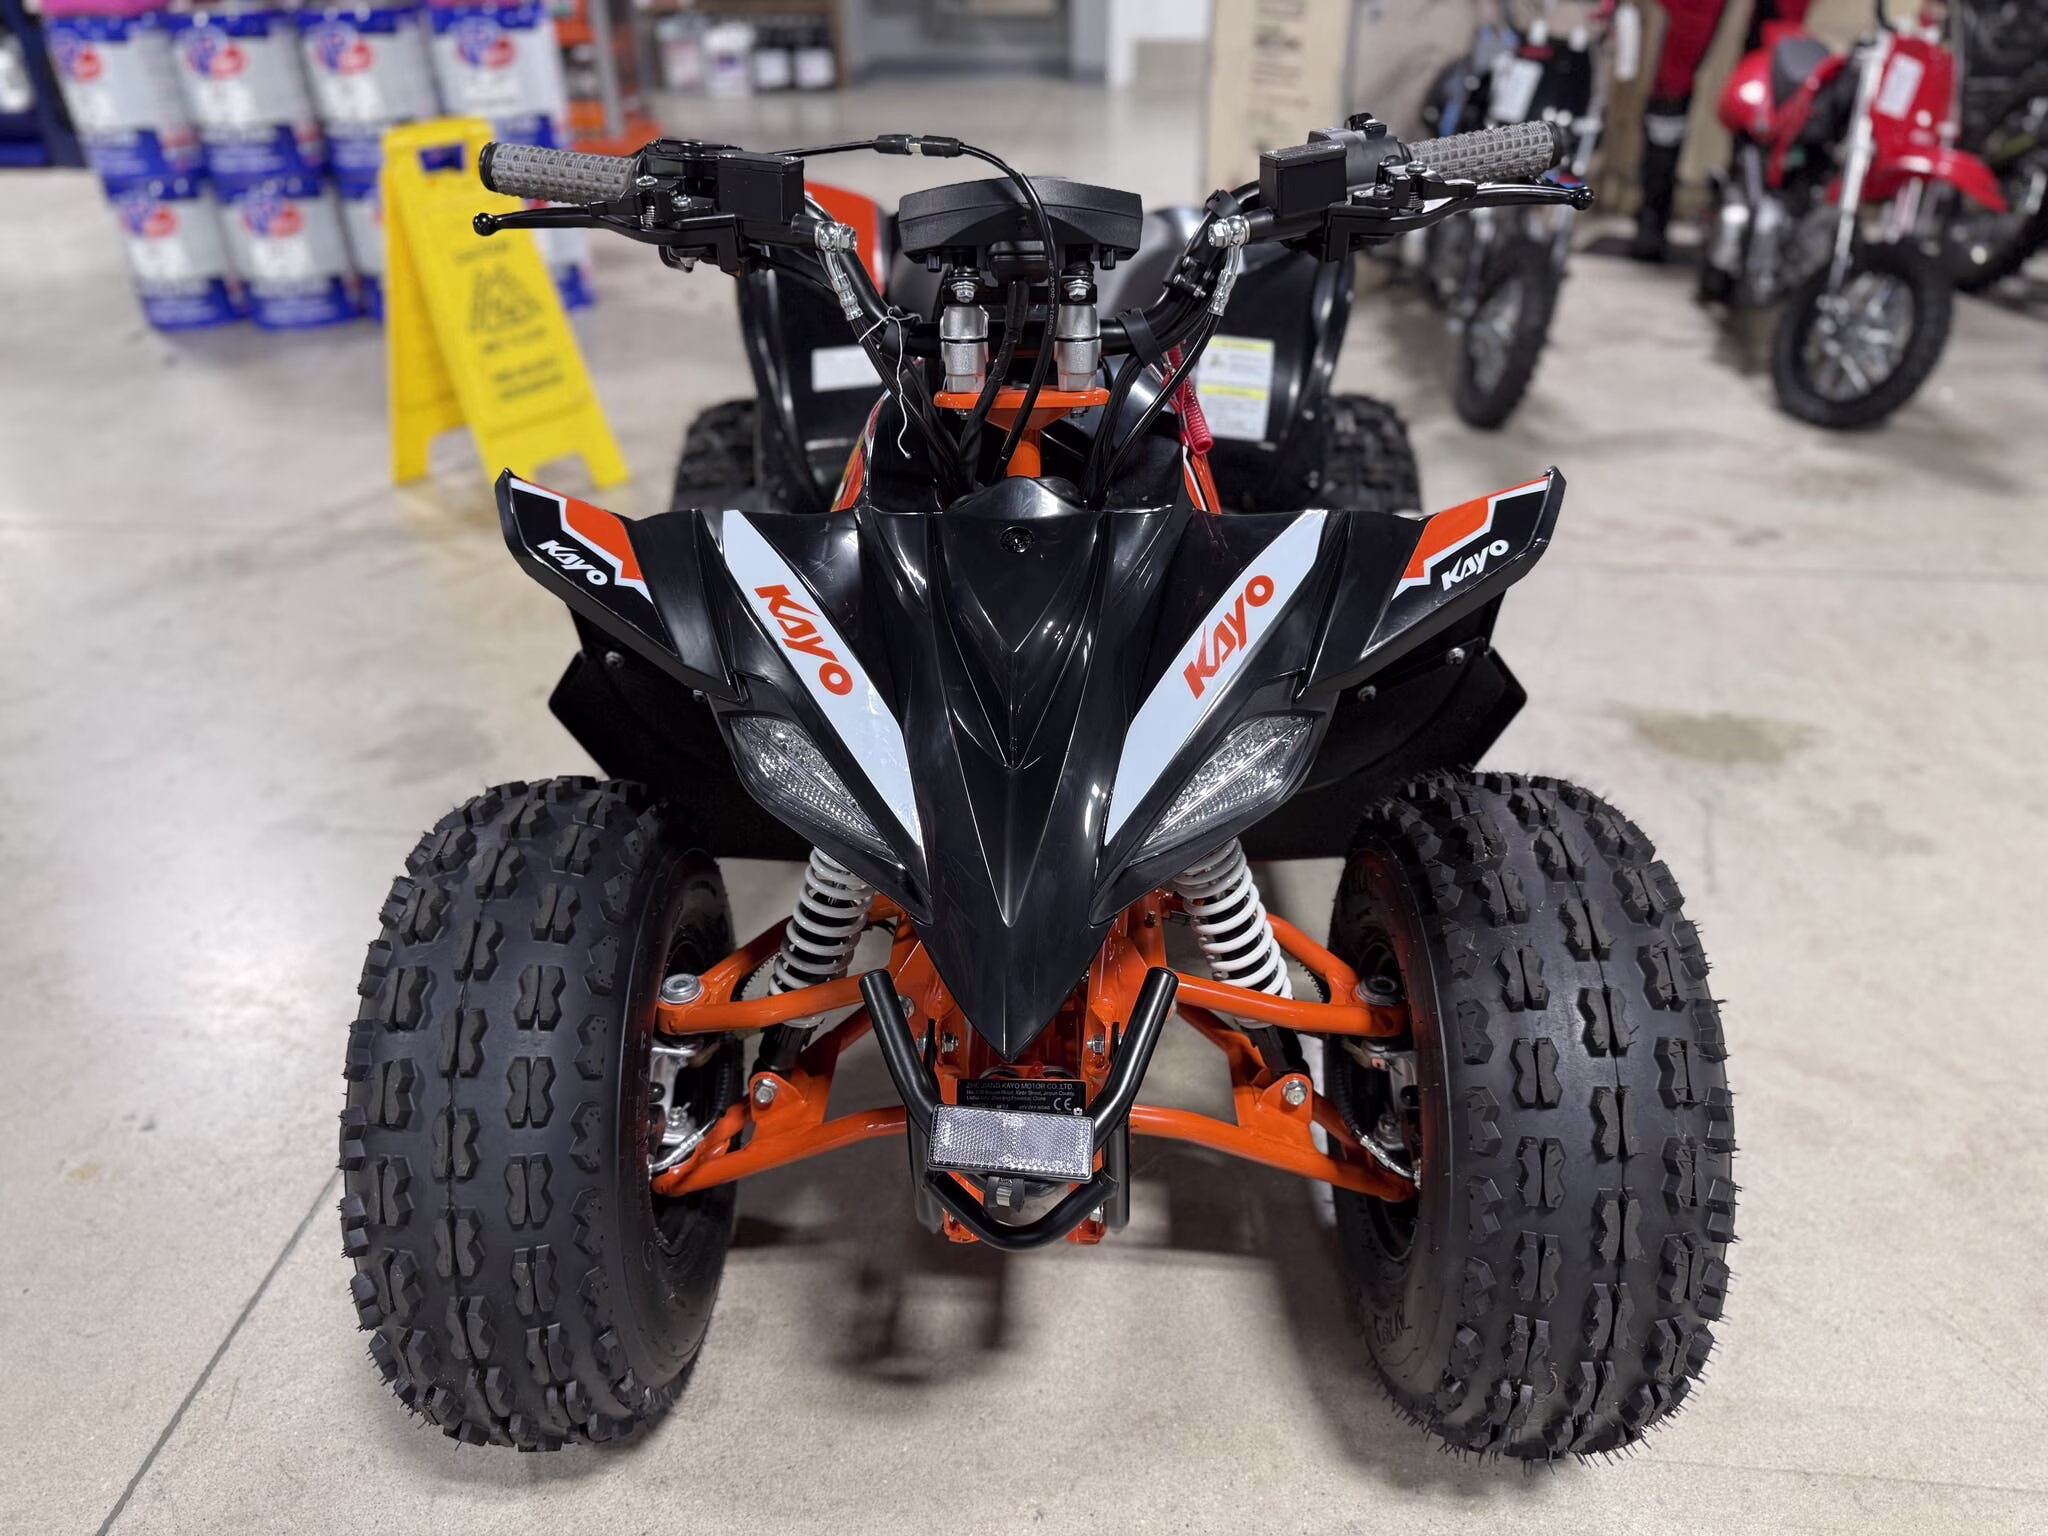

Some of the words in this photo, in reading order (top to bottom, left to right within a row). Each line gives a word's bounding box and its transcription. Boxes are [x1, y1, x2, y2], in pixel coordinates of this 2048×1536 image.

[754, 584, 854, 696] KAYO
[1183, 574, 1275, 700] KAYO
[1001, 1082, 1020, 1090] KAYO
[1021, 1082, 1046, 1090] MOTOR
